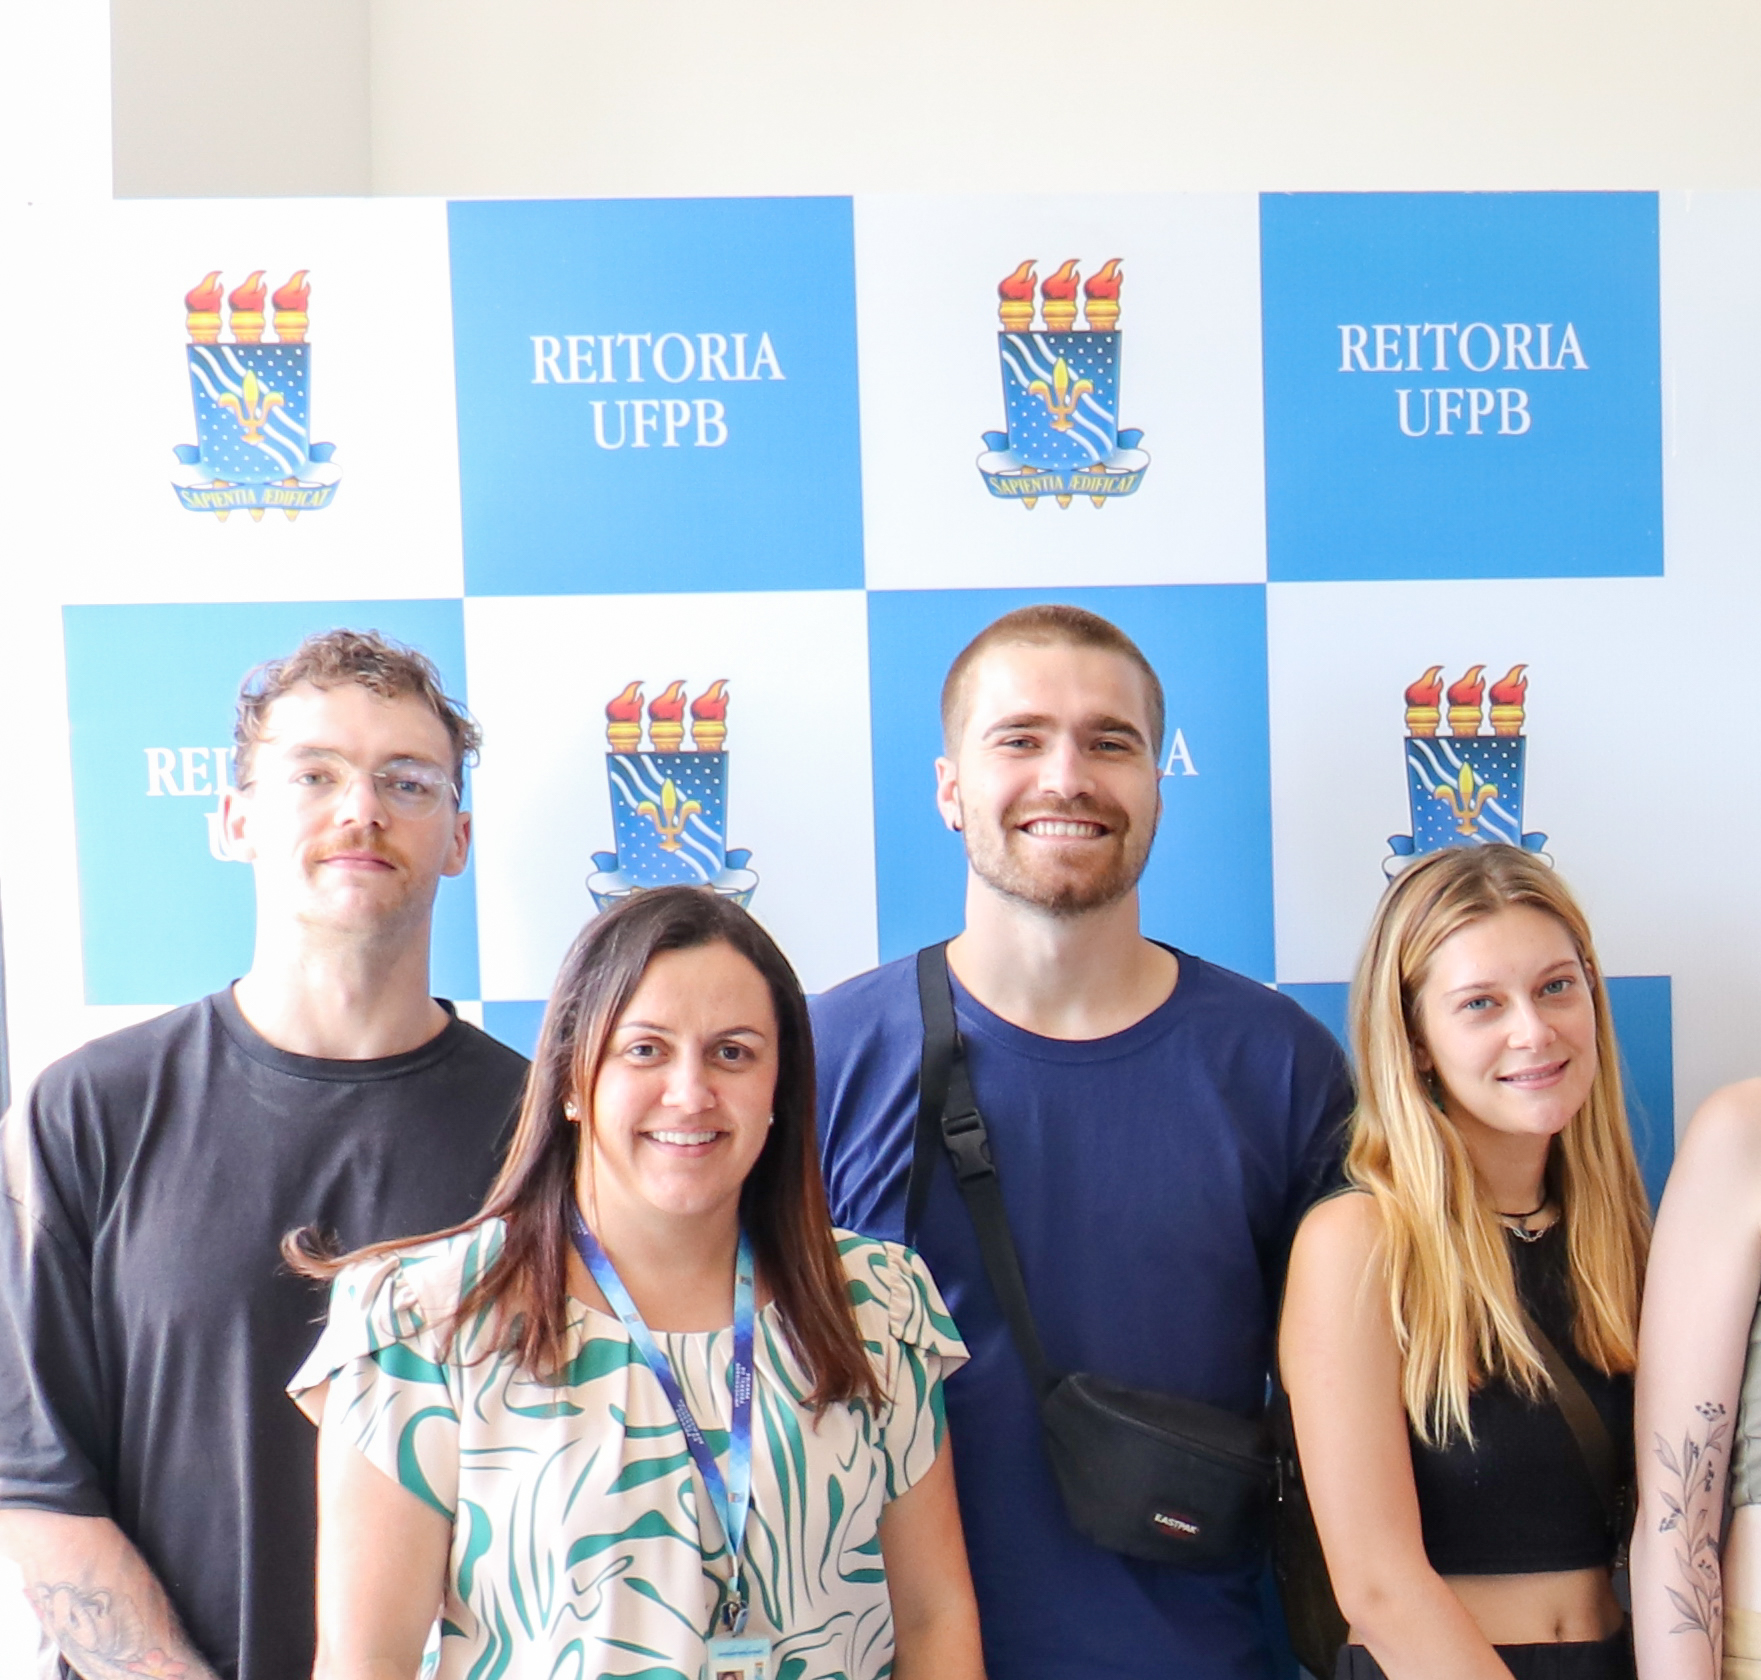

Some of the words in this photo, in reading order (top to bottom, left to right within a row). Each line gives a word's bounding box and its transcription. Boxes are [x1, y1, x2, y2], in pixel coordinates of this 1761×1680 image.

[530, 333, 785, 384] REITORIA
[1338, 322, 1589, 371] REITORIA
[590, 399, 728, 449] UFPB
[1396, 388, 1531, 436] UFPB
[1154, 1512, 1198, 1535] EASTPAK
